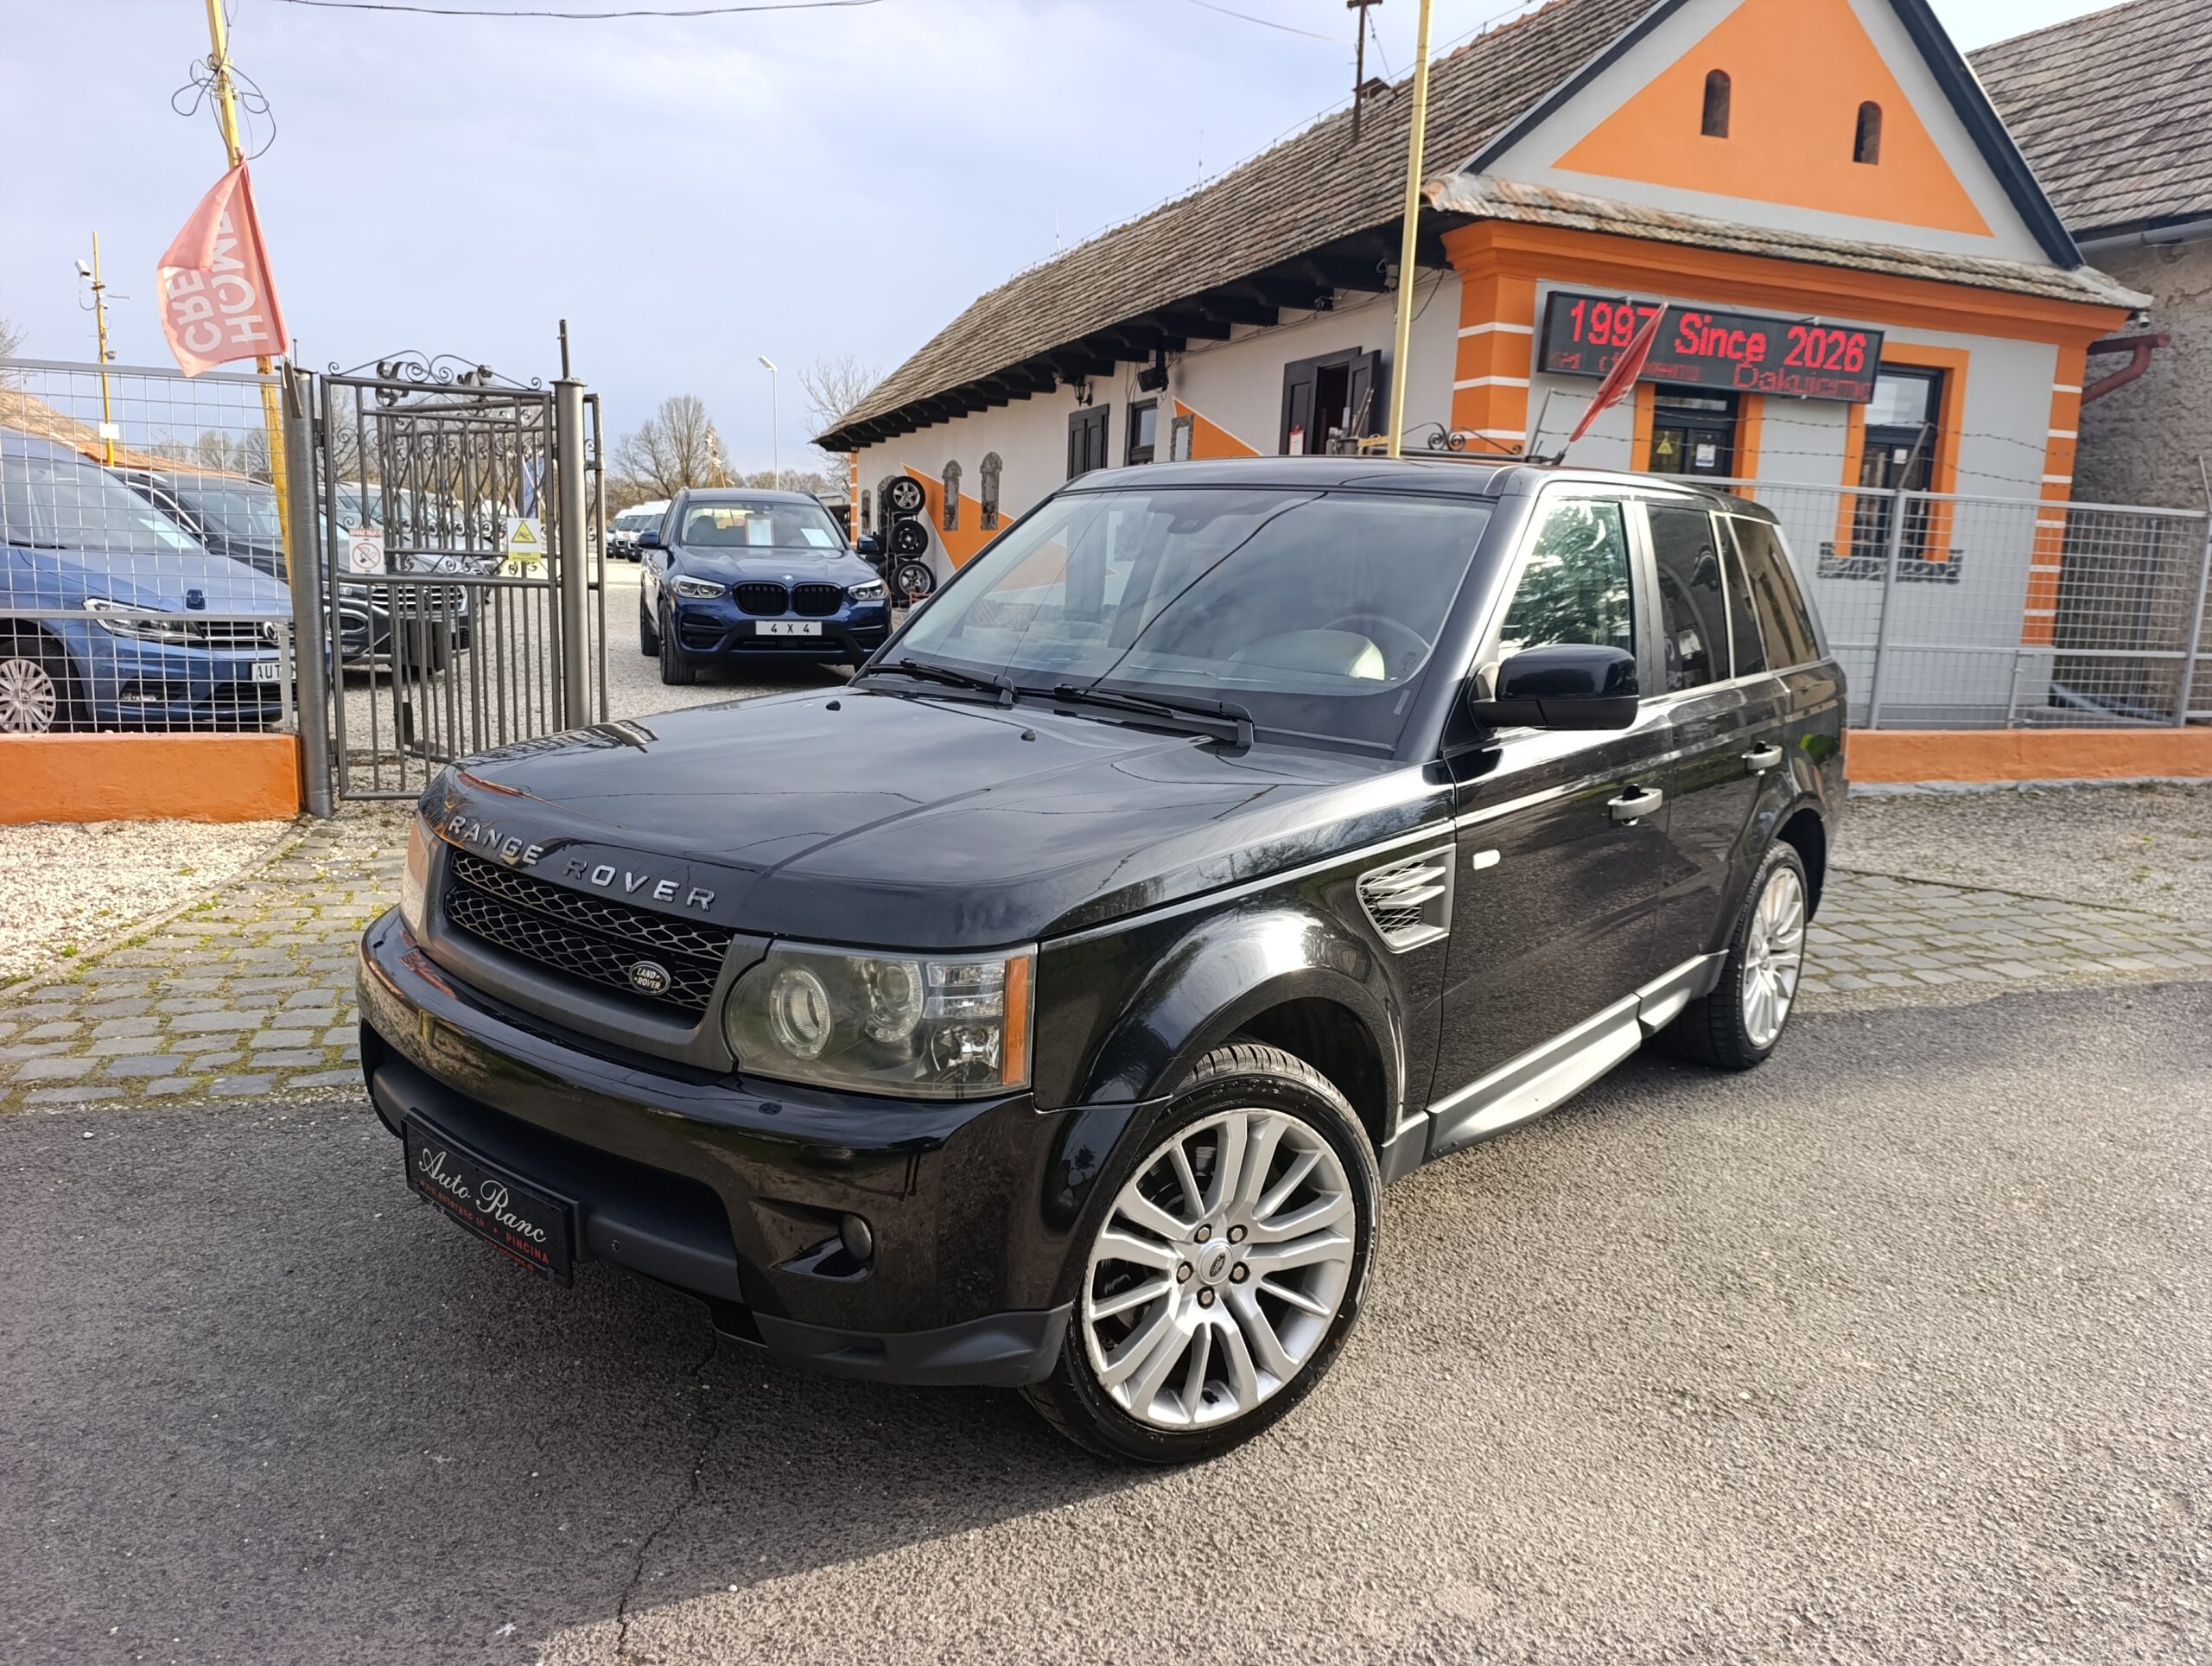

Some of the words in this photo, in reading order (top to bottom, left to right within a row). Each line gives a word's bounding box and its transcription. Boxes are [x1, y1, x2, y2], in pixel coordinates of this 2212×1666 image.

[1674, 312, 1766, 362] Since
[1783, 325, 1867, 373] 2026
[771, 623, 779, 633] 4
[787, 623, 794, 633] X
[803, 623, 810, 633] 4
[447, 814, 544, 865] RANGE
[562, 856, 716, 911] ROVER
[636, 967, 657, 979] LAND
[636, 976, 662, 990] ROVER
[418, 1148, 472, 1199] Auto
[475, 1180, 547, 1243] Ranc
[505, 1231, 550, 1264] PINCINA
